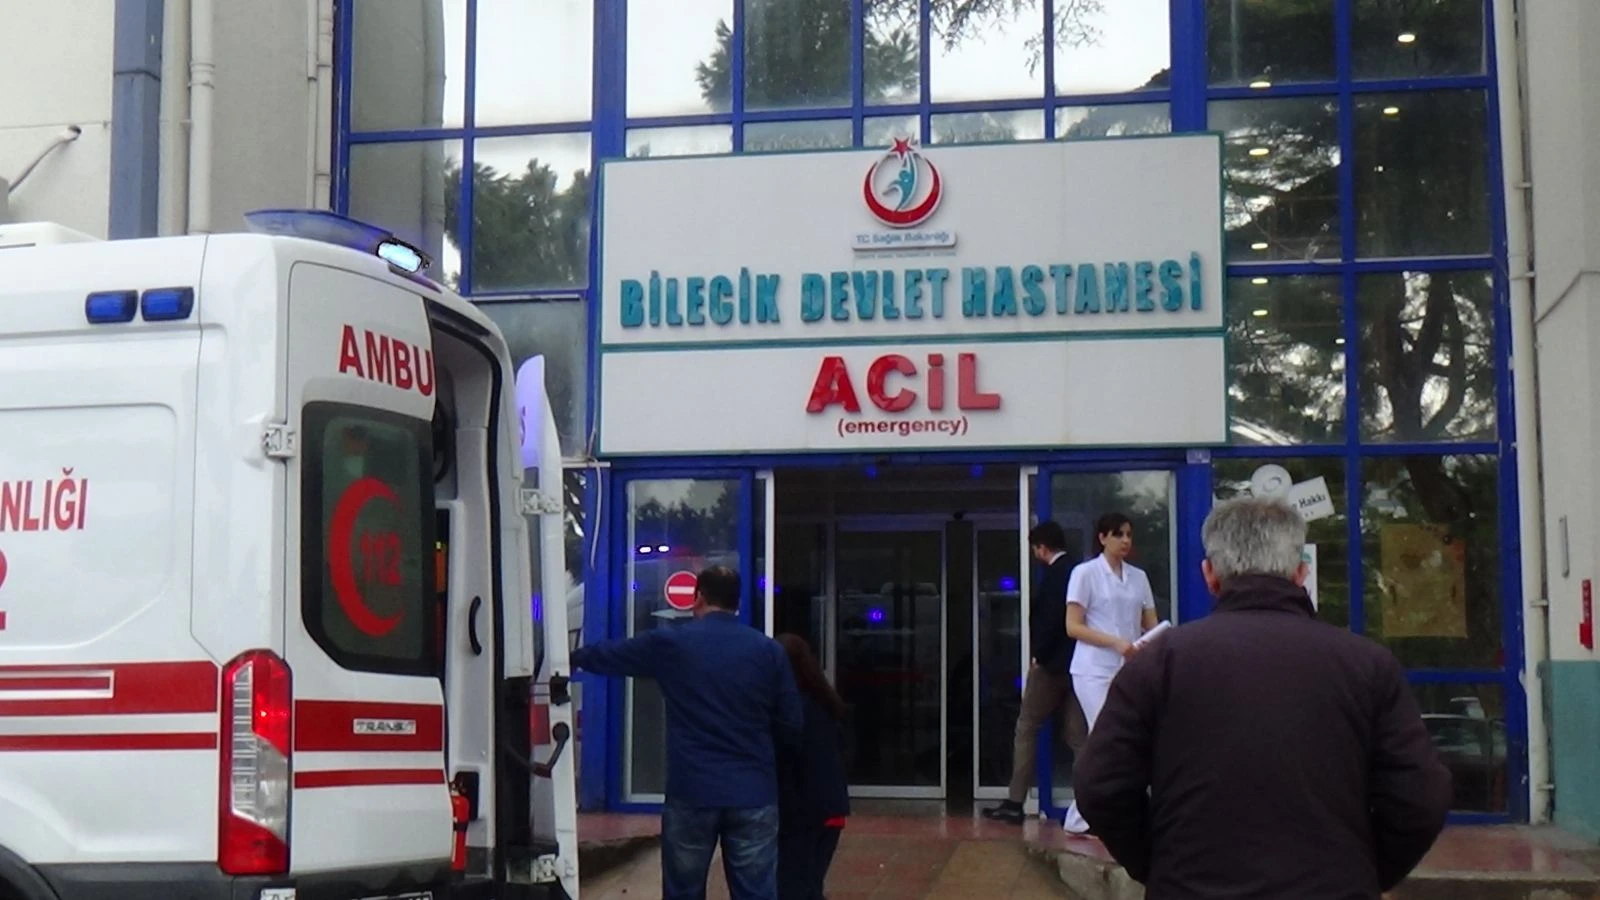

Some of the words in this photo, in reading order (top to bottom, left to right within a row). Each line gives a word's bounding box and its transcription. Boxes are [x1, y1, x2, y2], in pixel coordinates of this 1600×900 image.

[620, 266, 780, 328] BİLECİK
[801, 269, 949, 323] DEVLET
[962, 251, 1203, 318] HASTANESİ
[339, 324, 434, 397] AMBU
[838, 416, 968, 437] (emergency)
